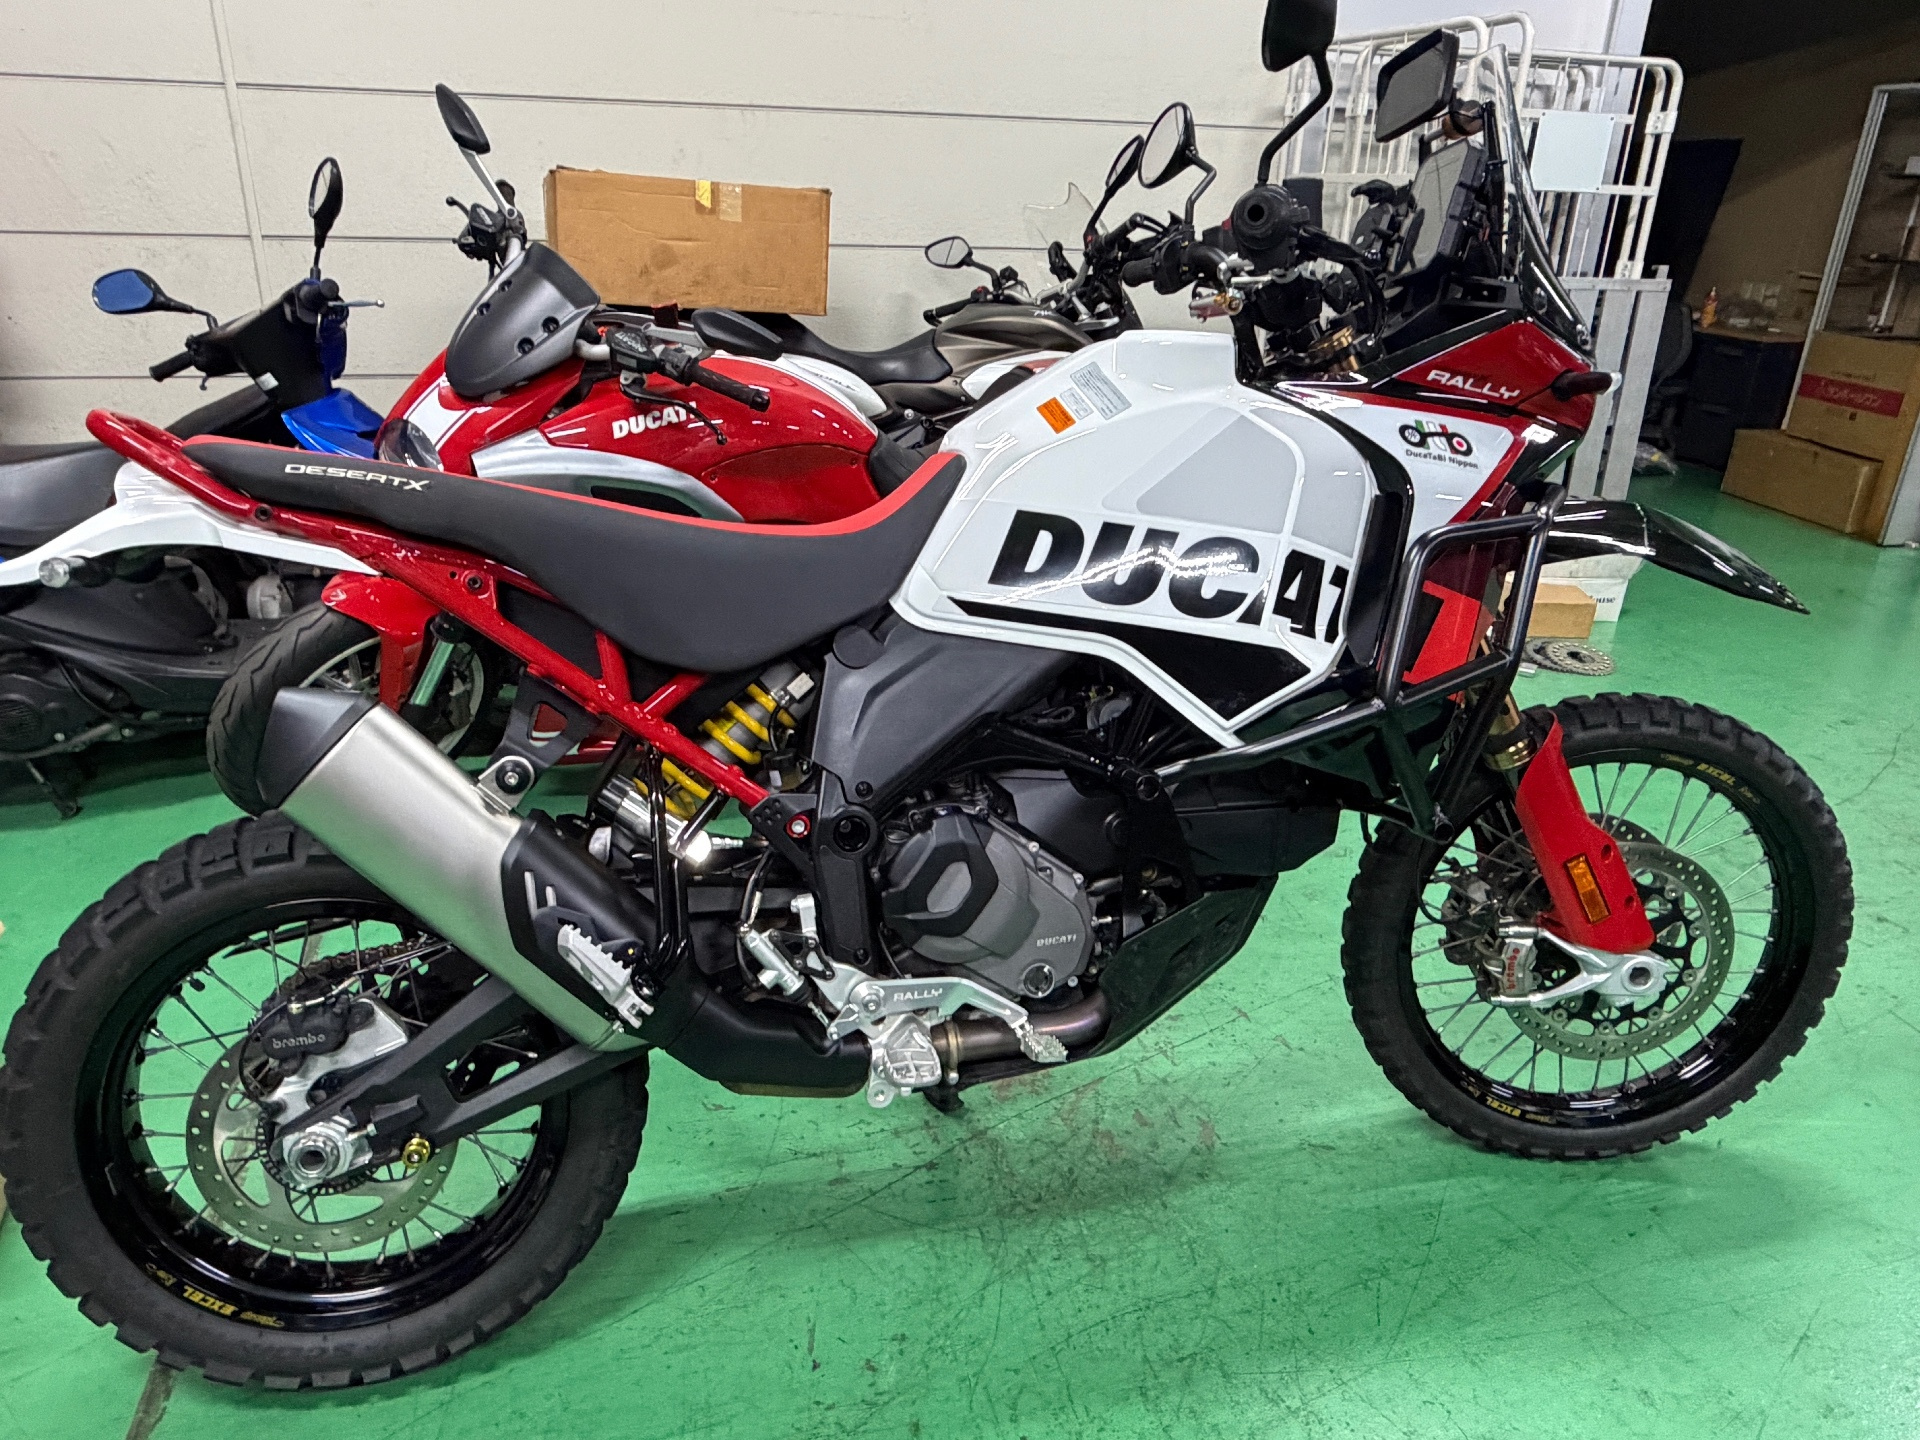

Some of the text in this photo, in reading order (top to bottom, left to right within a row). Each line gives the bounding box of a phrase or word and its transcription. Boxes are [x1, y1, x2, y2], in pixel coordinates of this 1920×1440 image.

[1426, 369, 1521, 399] RALLY
[1448, 456, 1479, 470] Nippon
[284, 463, 430, 491] DESERTX
[1036, 934, 1077, 947] DUCATI
[1506, 947, 1521, 990] brembo
[893, 987, 943, 1002] RALLY
[272, 1032, 327, 1049] brembo
[182, 1284, 240, 1316] EXCEL
